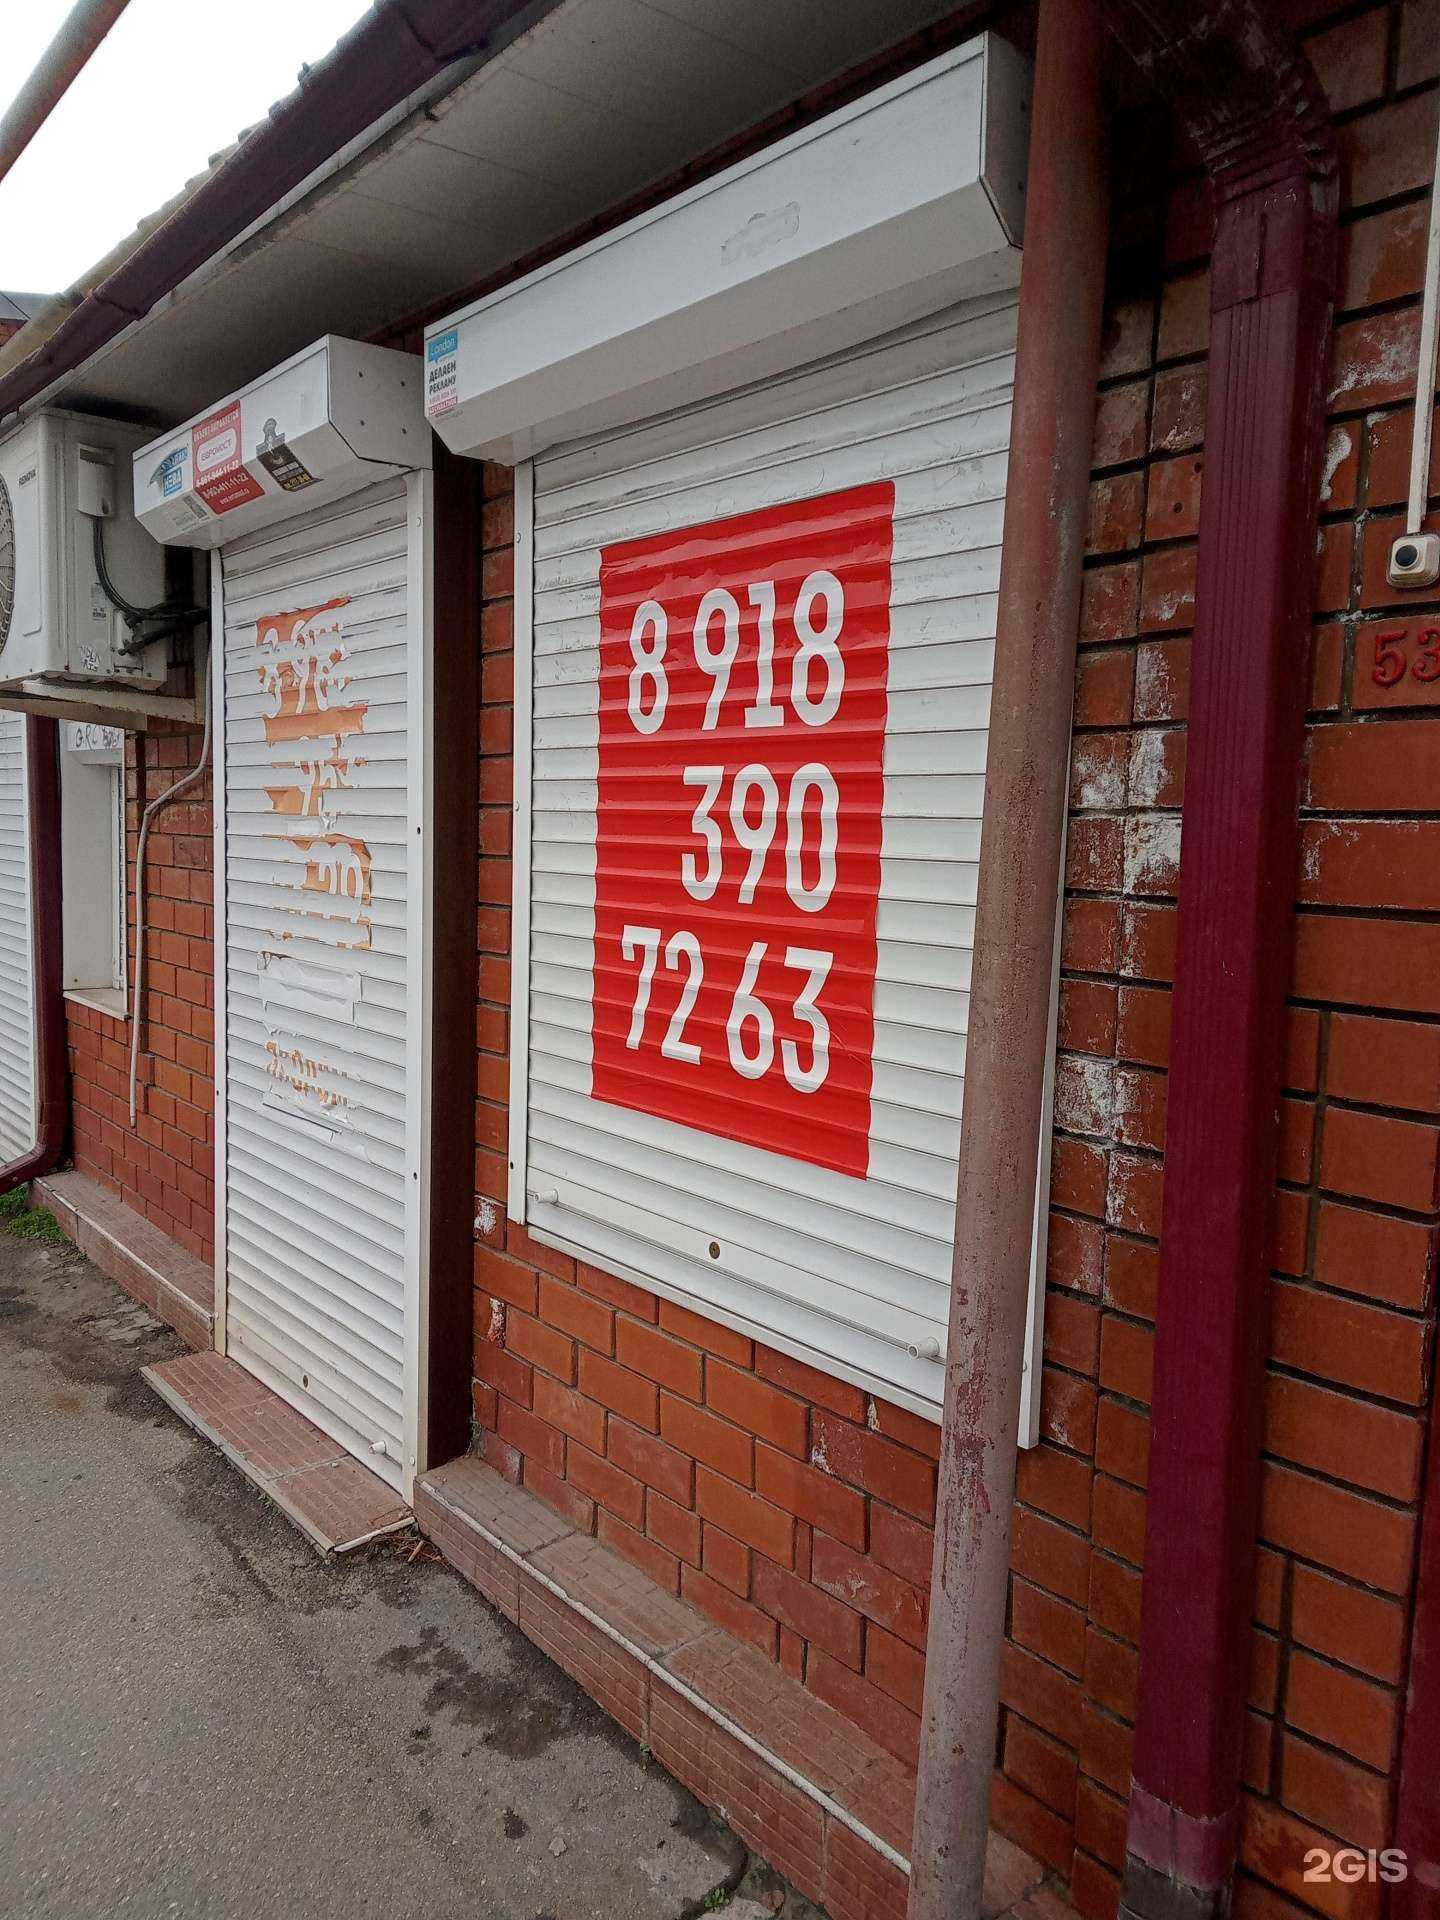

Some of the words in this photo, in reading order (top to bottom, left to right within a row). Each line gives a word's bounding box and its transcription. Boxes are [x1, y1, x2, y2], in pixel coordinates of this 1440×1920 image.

[429, 361, 457, 384] ДЕЛАЕМ
[429, 375, 457, 395] РЕКЛАМУ
[627, 601, 669, 734] 8
[692, 570, 845, 732] 918
[681, 762, 840, 913] 390
[621, 924, 705, 1066] 72
[725, 942, 833, 1094] 63
